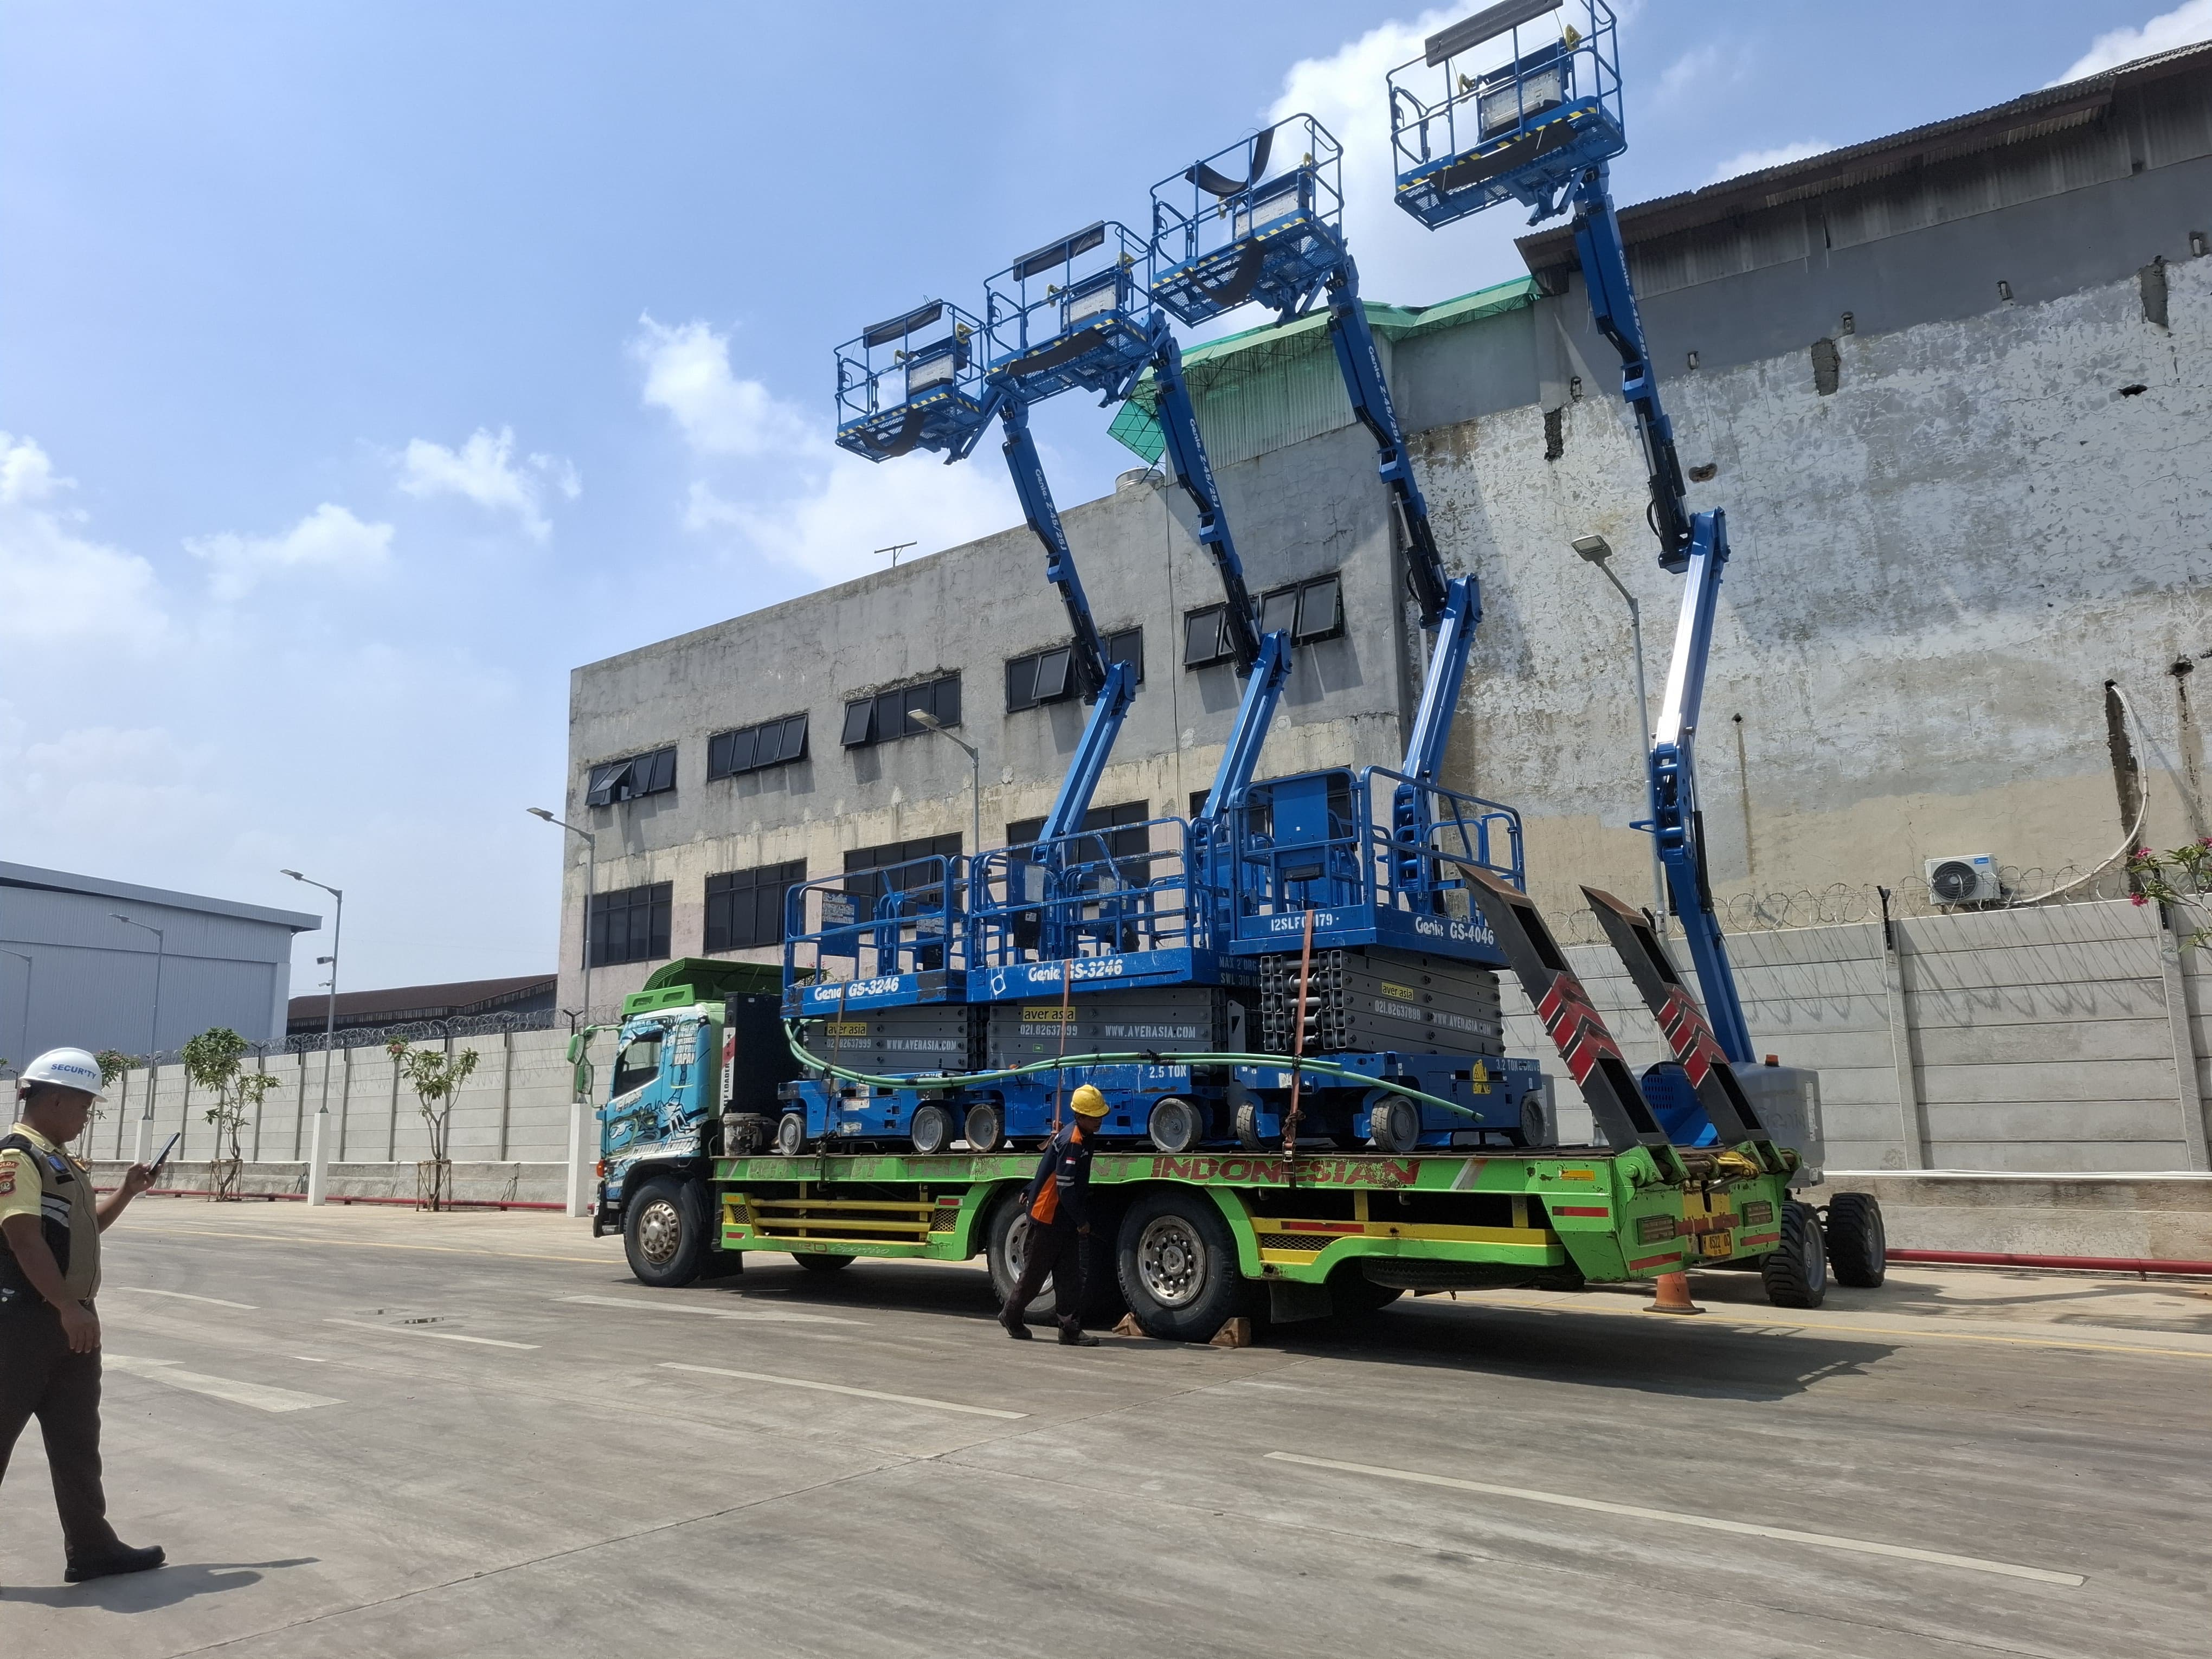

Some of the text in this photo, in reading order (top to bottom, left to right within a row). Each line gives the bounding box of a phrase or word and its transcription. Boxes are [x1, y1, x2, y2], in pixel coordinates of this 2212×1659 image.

[1629, 293, 1648, 360] Z-45/25J
[1379, 385, 1401, 443] Z-45/25J
[1199, 454, 1220, 509] Z-45/25J
[1046, 501, 1068, 551] Z-45/25J
[1450, 922, 1494, 945] GS-4046
[1219, 956, 1234, 969] MAX
[1028, 967, 1060, 982] Genie
[814, 977, 899, 1001] Genie GS-3246
[1382, 985, 1412, 1000] aver asia
[1024, 1009, 1074, 1020] aver asa
[849, 1024, 866, 1034] asia
[1149, 1065, 1187, 1079] 2.5 TON
[1496, 1059, 1506, 1071] 3.2
[1507, 1059, 1518, 1071] TON
